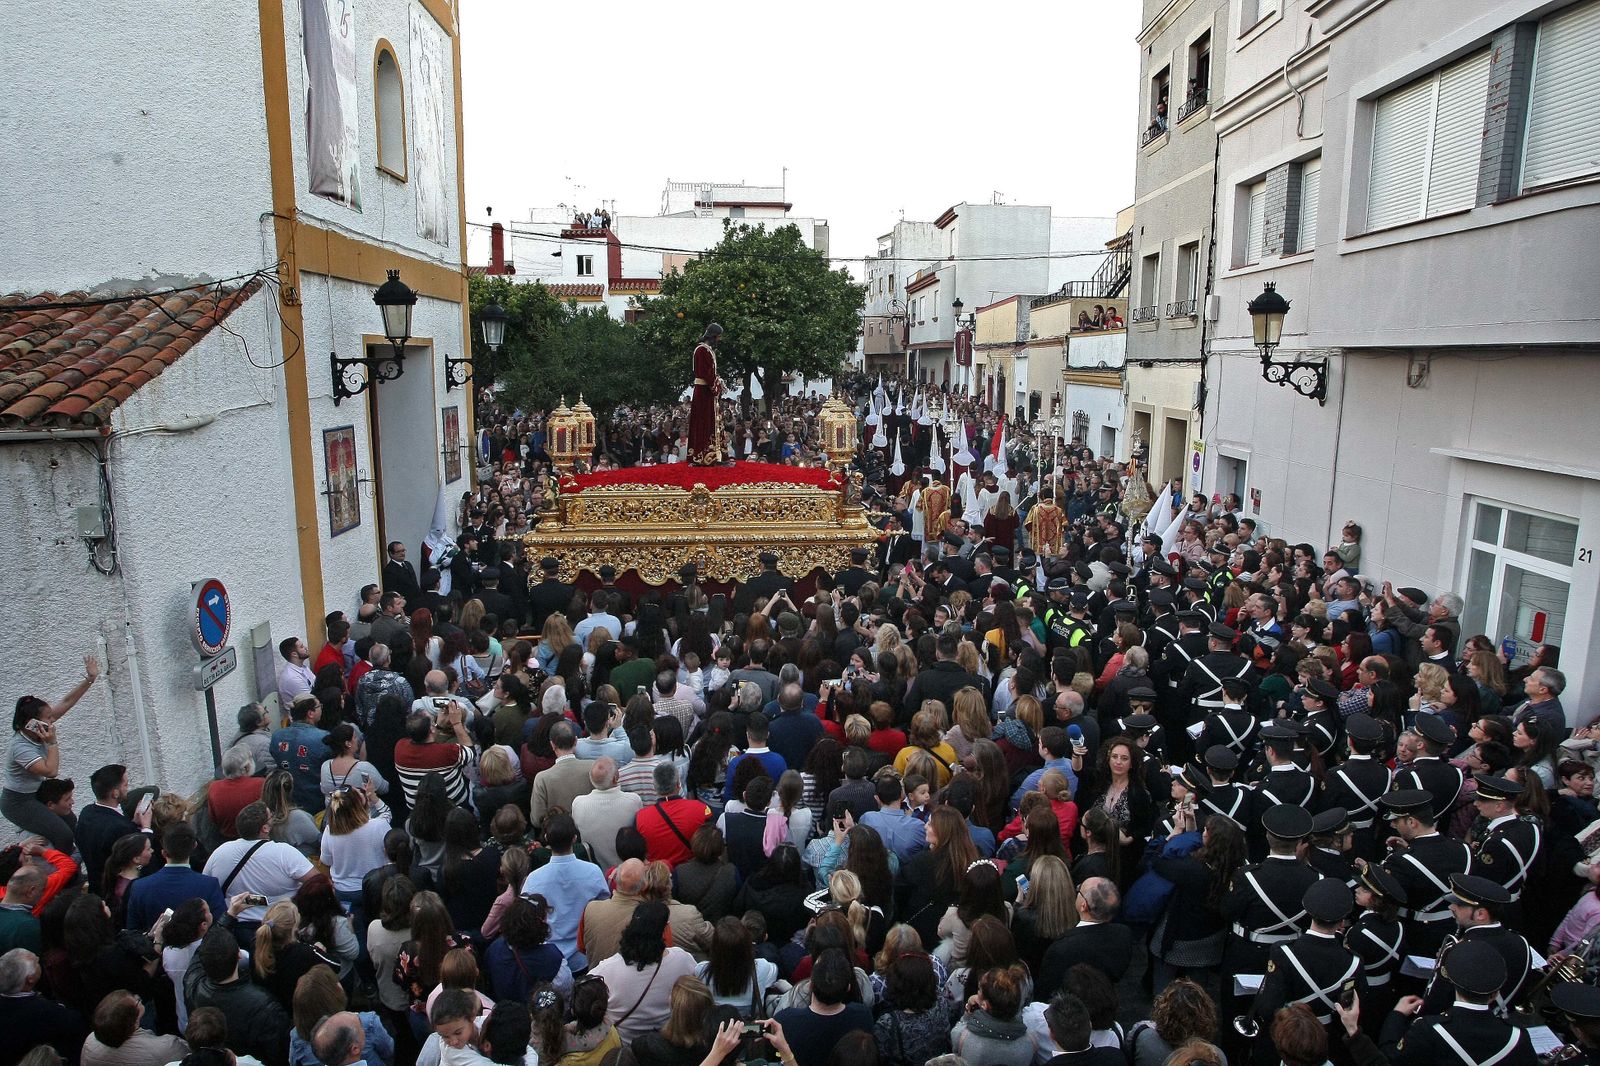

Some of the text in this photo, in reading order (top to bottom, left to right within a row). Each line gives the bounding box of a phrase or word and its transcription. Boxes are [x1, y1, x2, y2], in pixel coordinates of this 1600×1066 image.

[1578, 547, 1593, 564] 21
[203, 660, 235, 684] RETIRADA GRUA
